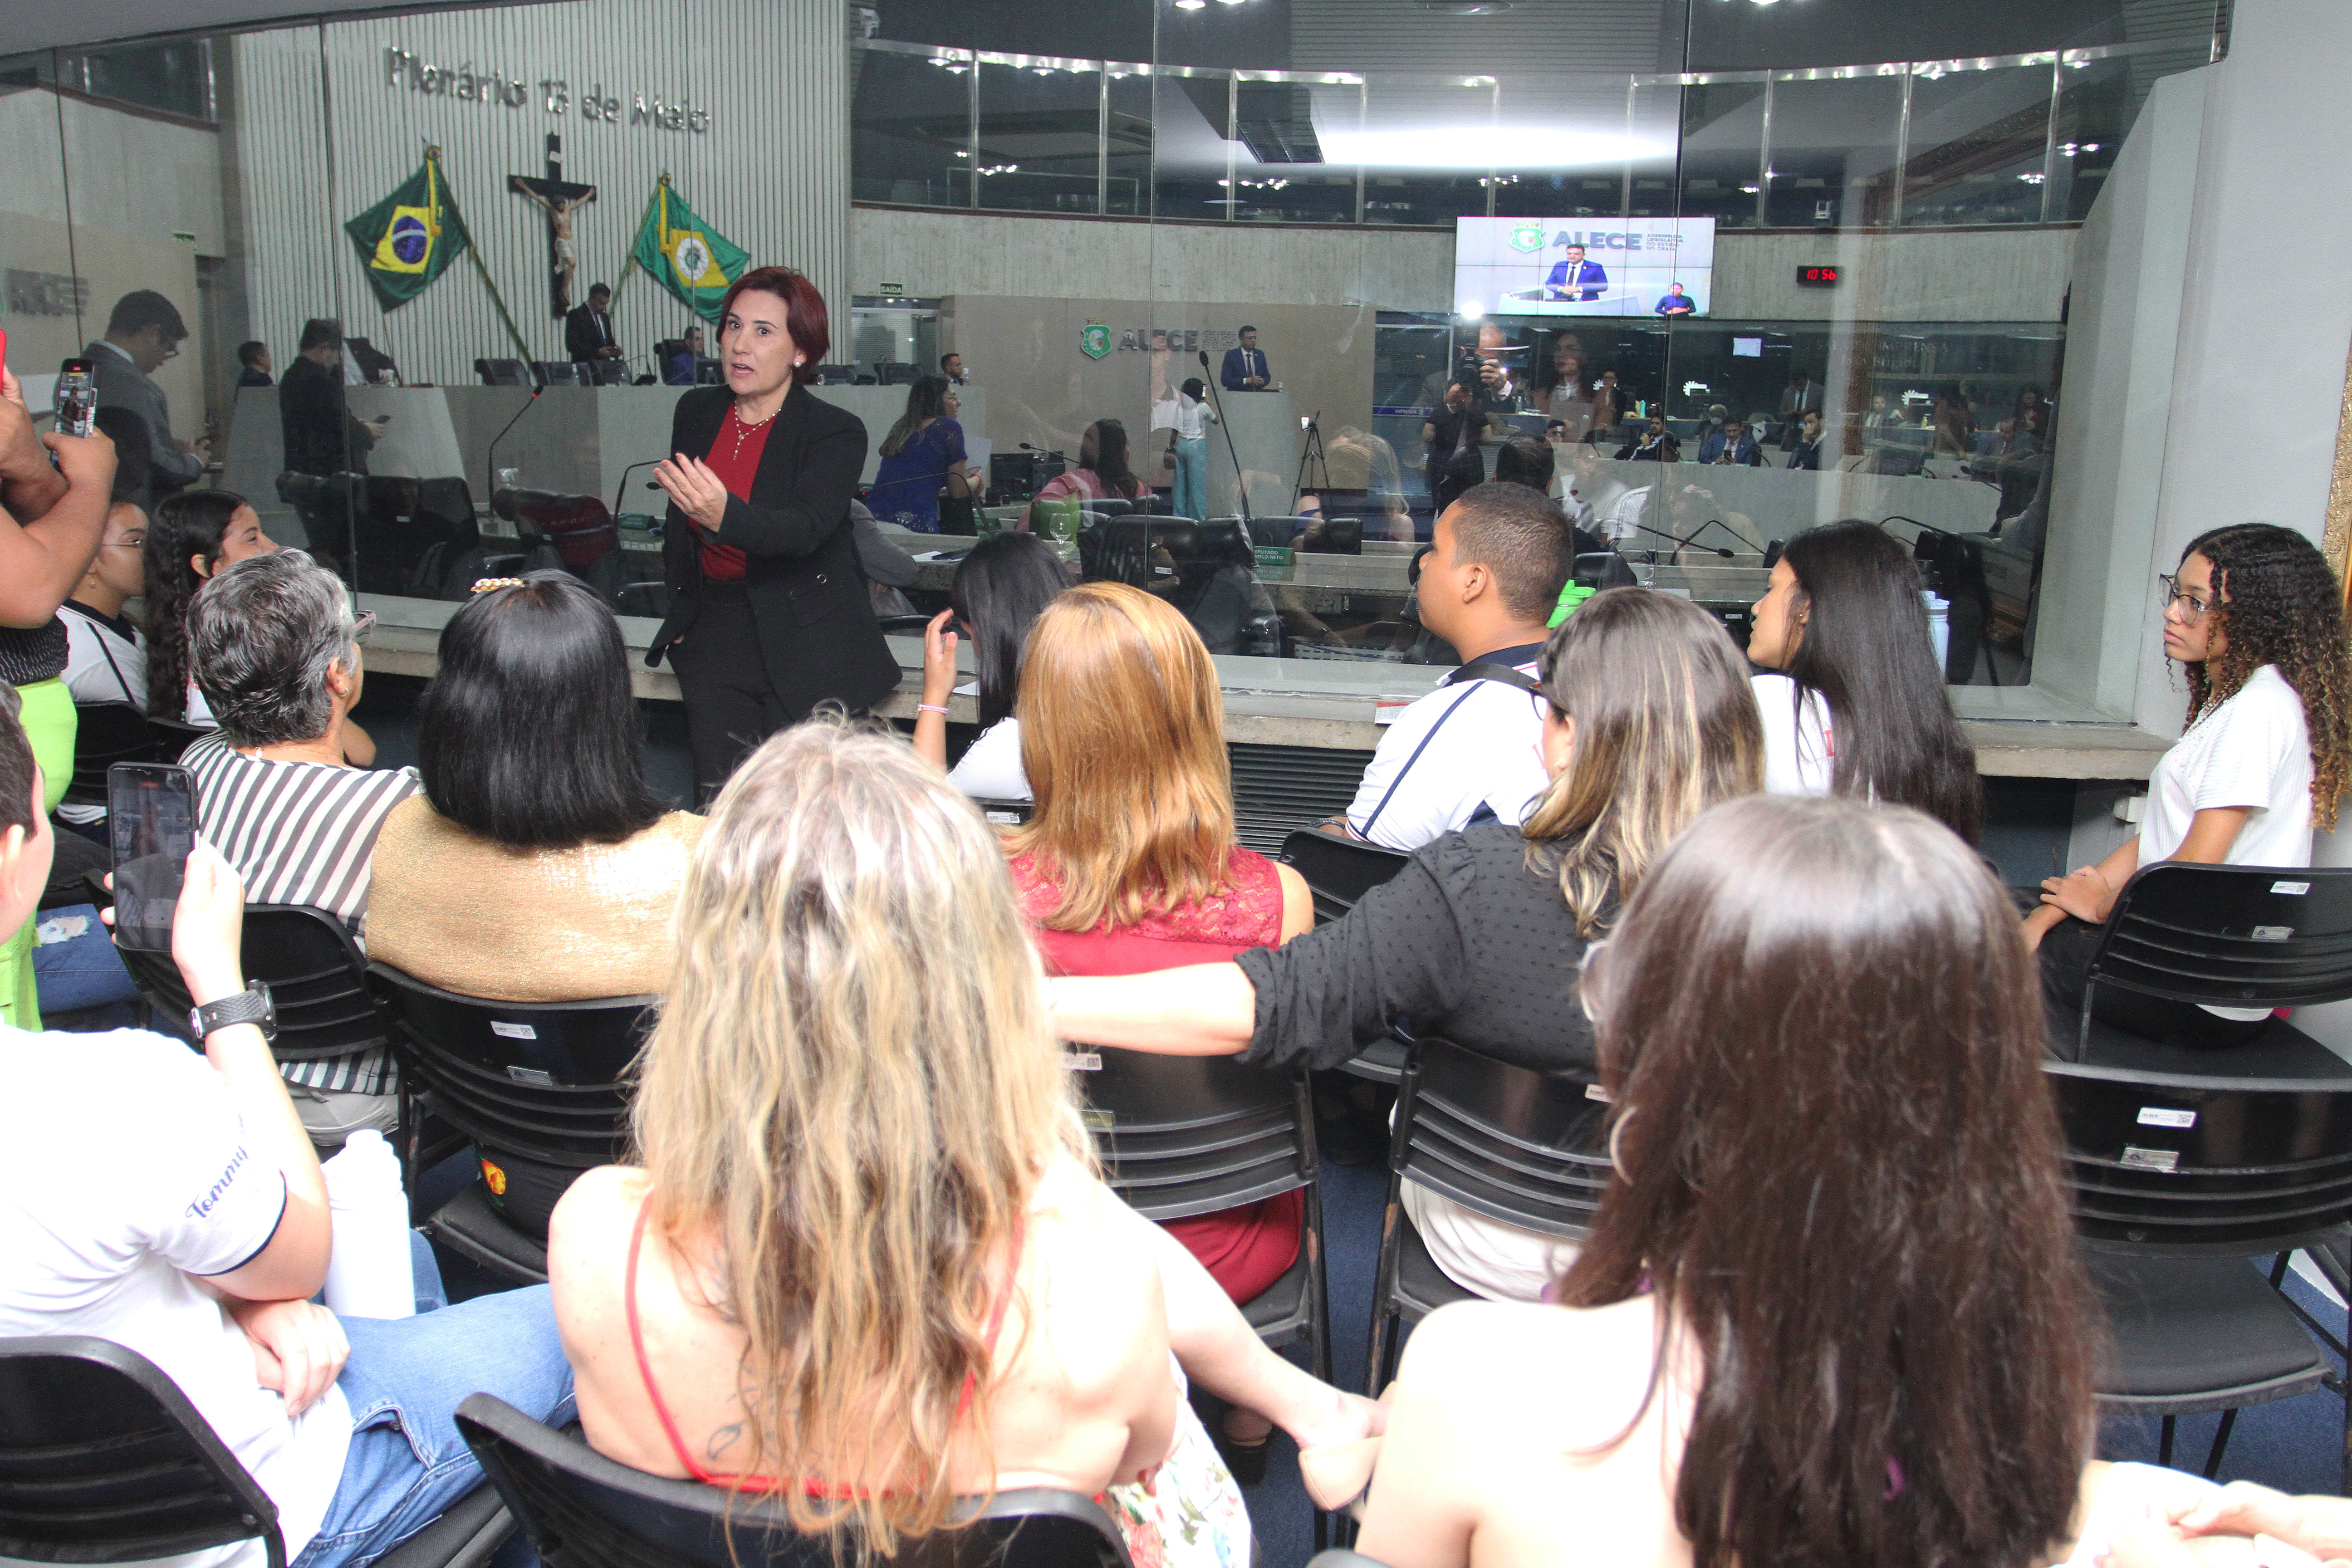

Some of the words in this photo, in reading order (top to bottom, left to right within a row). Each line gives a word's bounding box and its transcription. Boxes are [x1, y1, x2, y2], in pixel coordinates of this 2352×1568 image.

[384, 46, 527, 108] Plenário
[539, 79, 570, 114] 13
[582, 83, 620, 122] de
[632, 92, 710, 133] Maio
[1553, 231, 1642, 250] ALECE
[1118, 328, 1198, 352] ALECE
